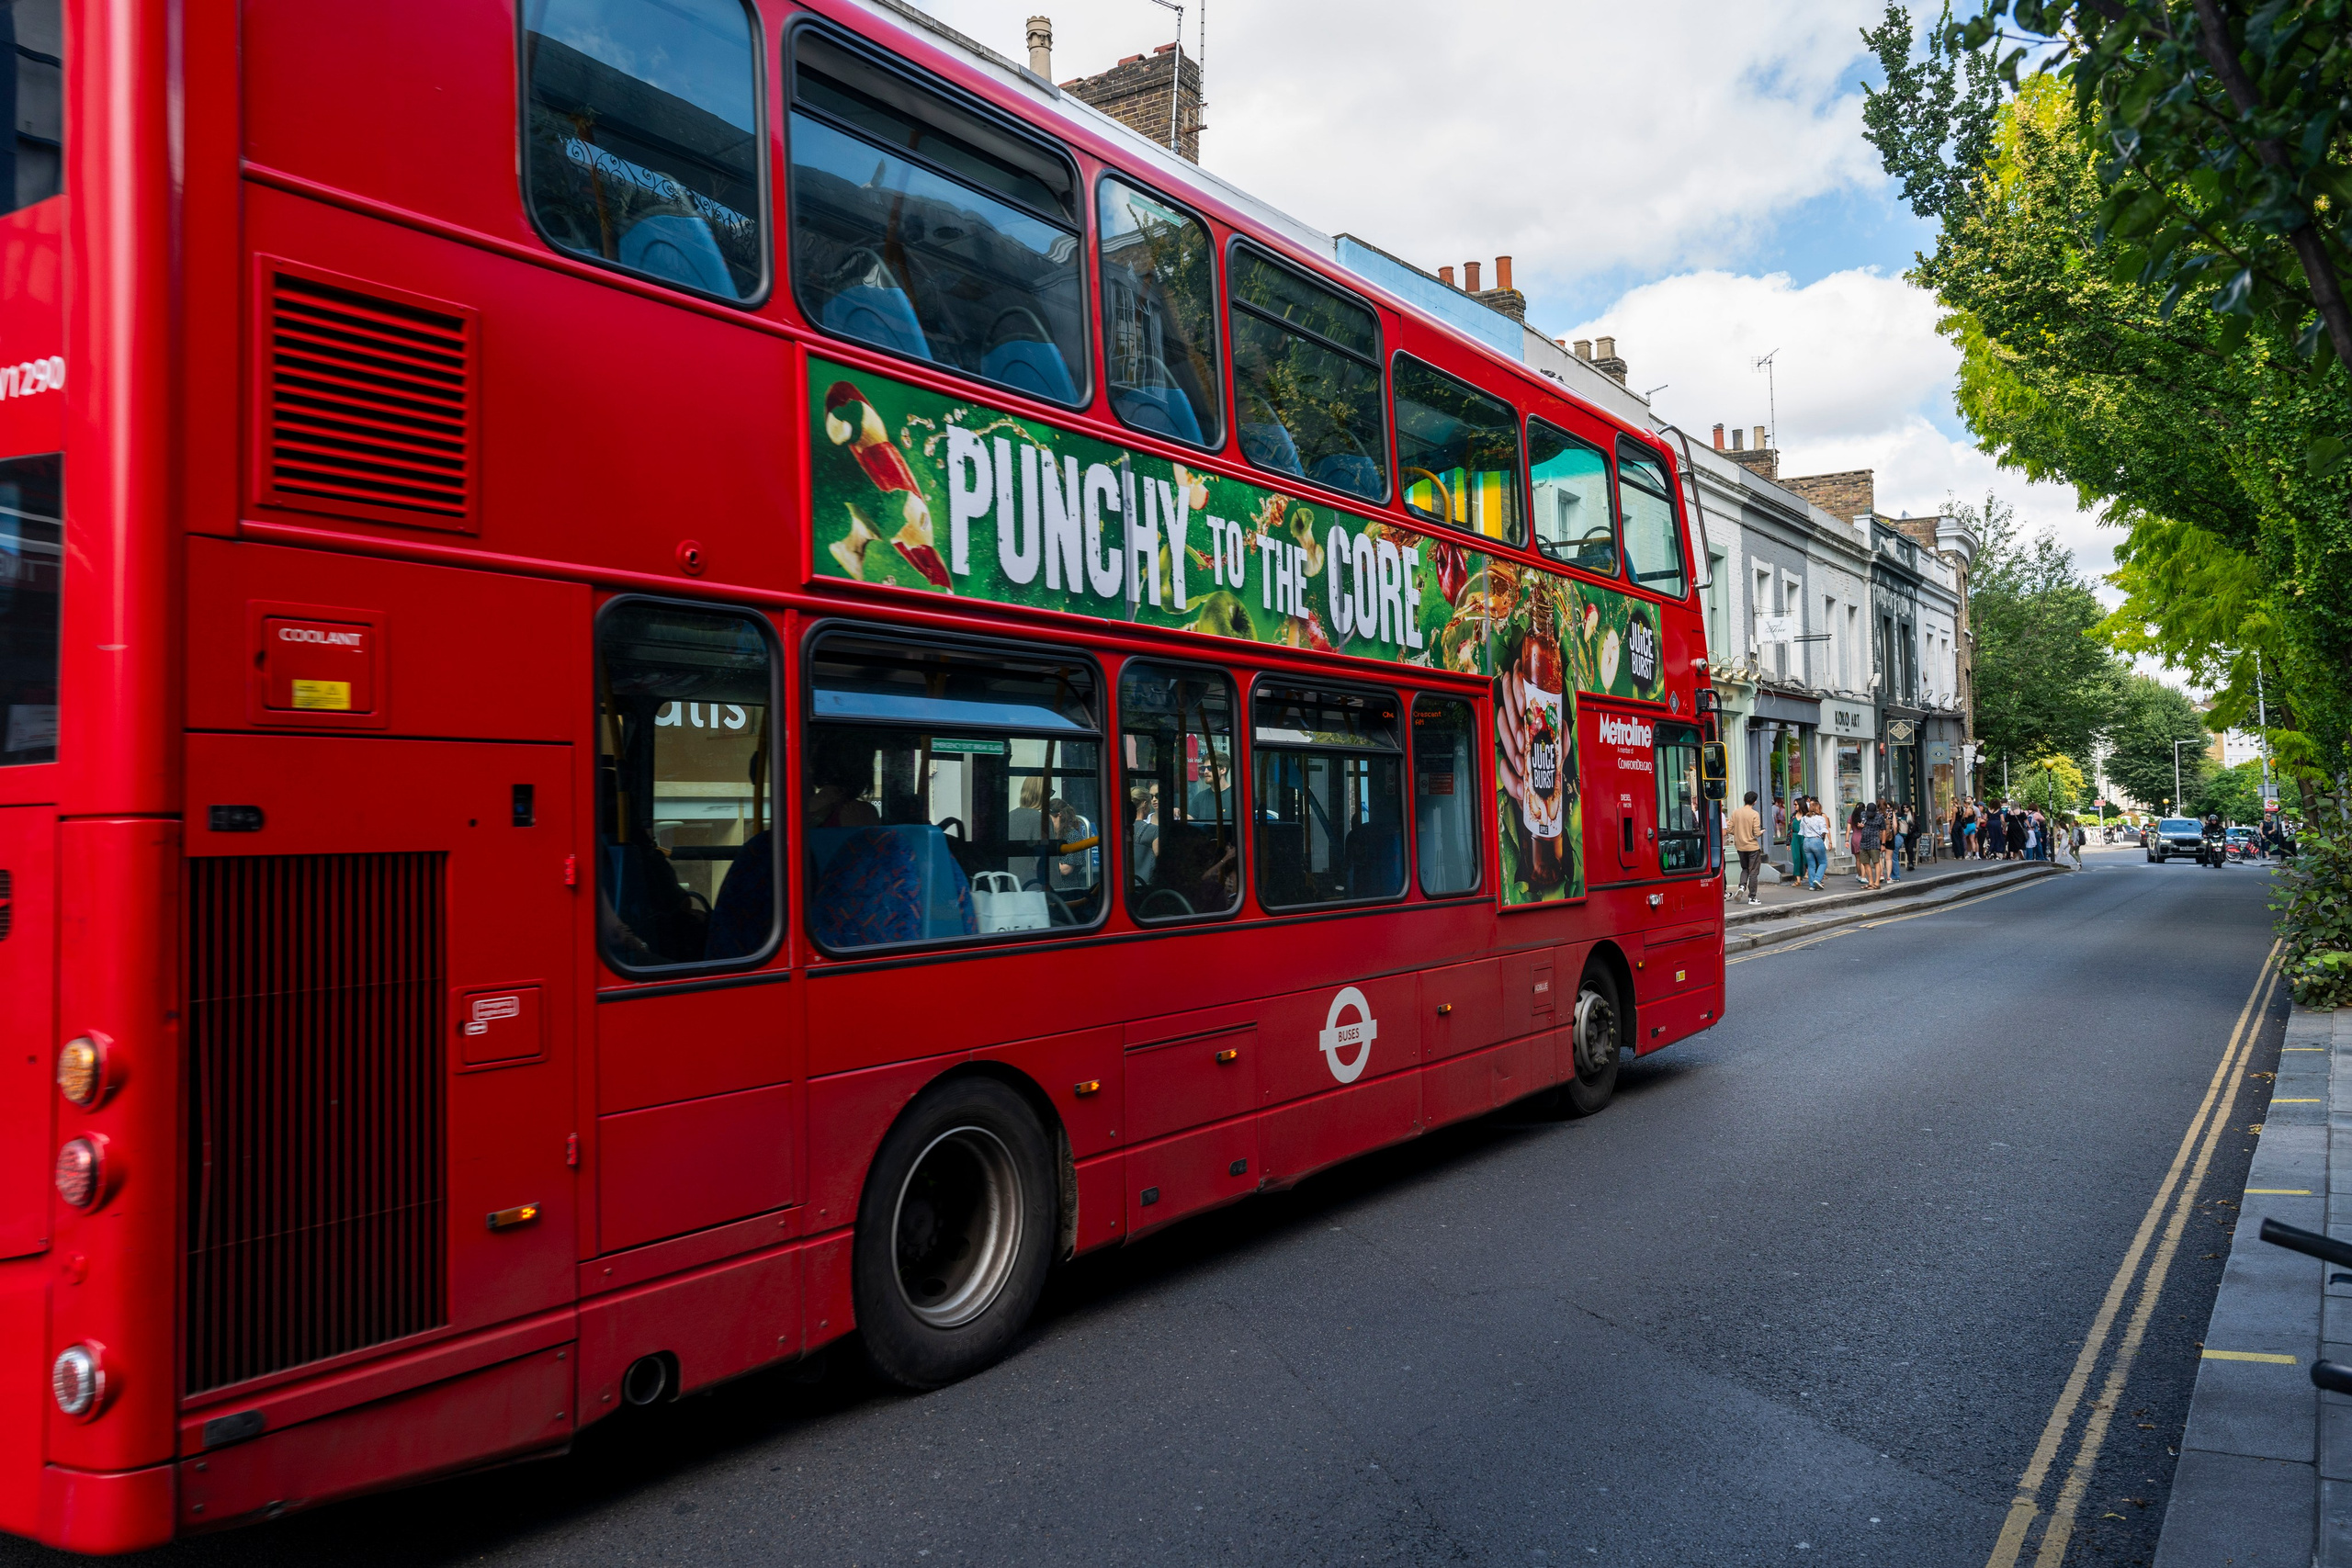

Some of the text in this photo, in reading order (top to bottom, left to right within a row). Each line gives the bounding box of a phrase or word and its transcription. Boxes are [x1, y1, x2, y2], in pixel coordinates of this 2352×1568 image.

[946, 423, 1424, 650] PUNCHY TO THE CORE
[278, 627, 363, 646] COOLANT
[1632, 651, 1654, 681] BURST
[1413, 710, 1442, 718] Crescent
[1835, 710, 1860, 728] KOKO ART
[1599, 712, 1652, 748] Metroline
[1534, 769, 1555, 789] BURST
[1338, 1027, 1360, 1043] BUSES
